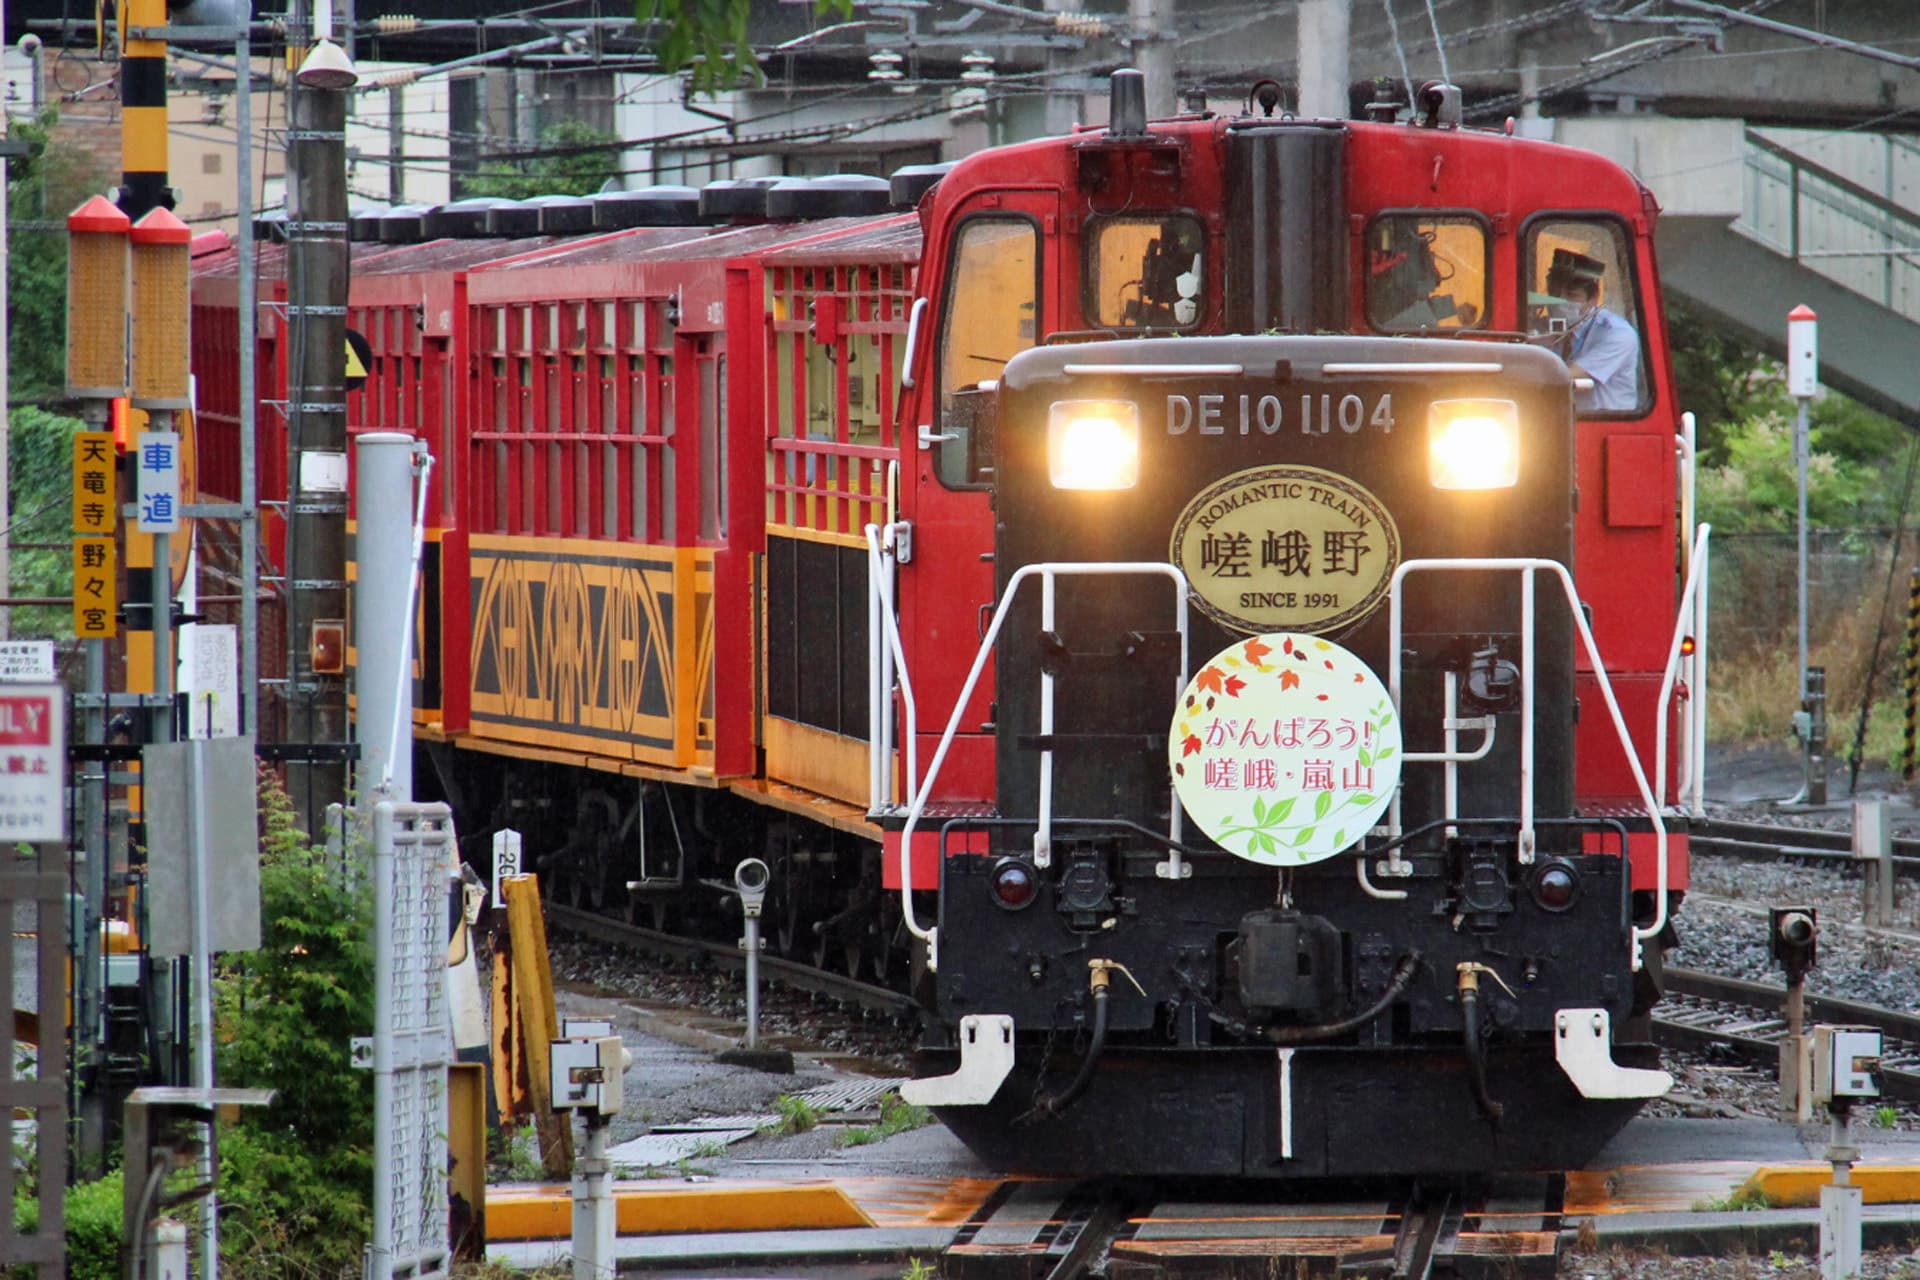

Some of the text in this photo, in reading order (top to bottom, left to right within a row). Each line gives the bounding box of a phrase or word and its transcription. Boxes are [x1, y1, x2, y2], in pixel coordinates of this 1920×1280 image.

[1301, 393, 1396, 435] 1104
[82, 439, 106, 526] 天竜寺
[142, 442, 173, 523] 車道
[1197, 483, 1372, 531] ROMANTIC TRAIN
[1200, 529, 1372, 578] 嵯峨野
[82, 543, 106, 631] 野々宮
[1239, 592, 1340, 608] SINCE 1991
[1204, 758, 1375, 791] 嵯峨・嵐山
